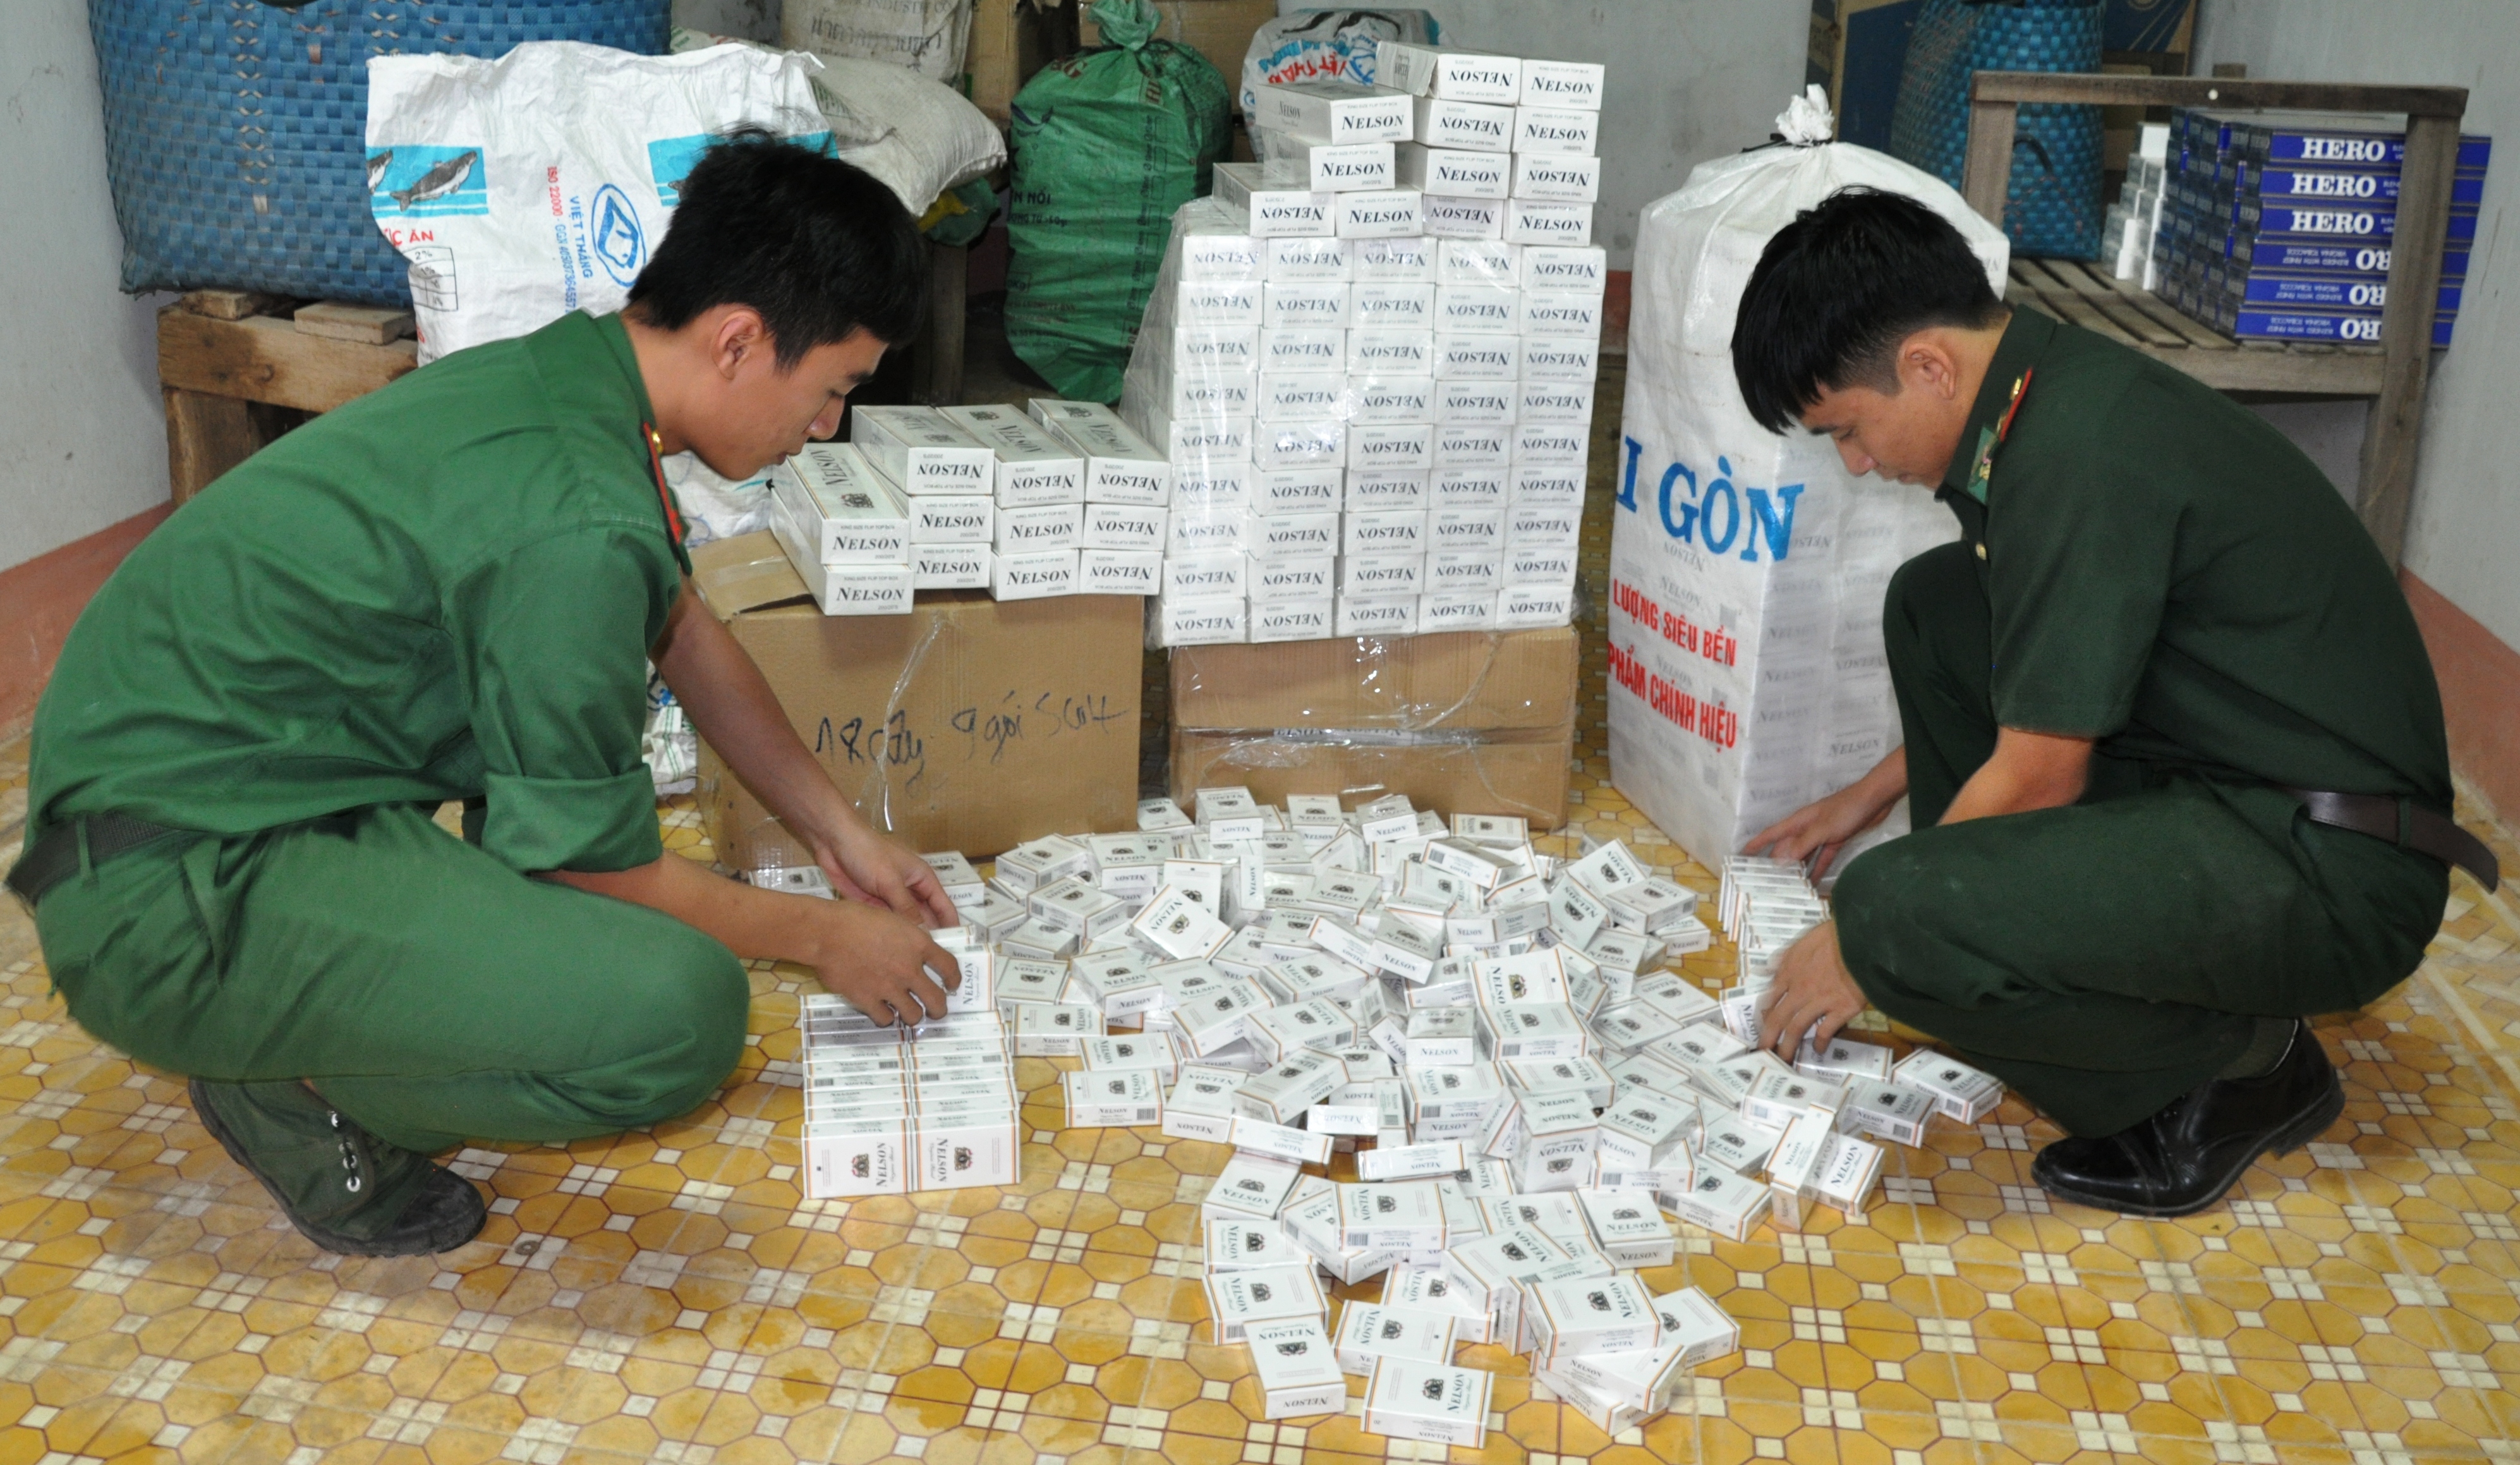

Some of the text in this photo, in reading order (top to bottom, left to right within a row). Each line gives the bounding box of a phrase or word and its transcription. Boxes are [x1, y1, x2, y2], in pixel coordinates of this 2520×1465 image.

[1450, 70, 1510, 87] NELSON
[1532, 76, 1594, 94] NELSON
[1342, 114, 1403, 130] NELSON
[1439, 116, 1505, 136] NELSON
[1525, 123, 1587, 141] NELSON
[2301, 137, 2385, 161] HERO
[548, 166, 558, 183] ISO
[1323, 162, 1385, 176] NELSON
[1436, 166, 1501, 183] NELSON
[1529, 169, 1590, 187] NELSON
[2291, 173, 2377, 198] HERO
[550, 186, 563, 216] 22000
[569, 196, 584, 229] VIỆT
[1261, 207, 1325, 221] NELSON
[1349, 209, 1414, 224] NELSON
[1430, 207, 1491, 224] NELSON
[1519, 215, 1582, 231] NELSON
[2291, 210, 2375, 234] HERO
[2355, 249, 2391, 271] RO
[1535, 264, 1596, 279] NELSON
[2348, 284, 2387, 306] RO
[1361, 300, 1425, 314] NELSON
[1528, 308, 1592, 324] NELSON
[2340, 319, 2382, 340] RO
[1360, 346, 1422, 360] NELSON
[1526, 352, 1590, 368] NELSON
[1364, 395, 1427, 410] NELSON
[1446, 396, 1509, 411] NELSON
[1362, 441, 1425, 455] NELSON
[917, 464, 984, 479] NELSON
[1010, 474, 1075, 490] NELSON
[1098, 473, 1162, 492] NELSON
[1439, 480, 1501, 494] NELSON
[1271, 484, 1334, 499] NELSON
[1659, 455, 1804, 562] GÒN
[919, 513, 985, 528] NELSON
[1094, 520, 1158, 536] NELSON
[1010, 523, 1072, 539] NELSON
[1357, 525, 1419, 540] NELSON
[832, 535, 901, 550] NELSON
[916, 559, 980, 574] NELSON
[1089, 566, 1153, 580] NELSON
[1357, 567, 1417, 581] NELSON
[1007, 569, 1070, 585] NELSON
[1175, 570, 1237, 585] NELSON
[836, 587, 905, 602] NELSON
[1350, 607, 1407, 621] NELSON
[1507, 601, 1565, 614] NELSON
[1613, 578, 1658, 631] LƯỢNG
[1663, 611, 1698, 653] SIÊU
[1174, 617, 1235, 631] NELSON
[1651, 674, 1695, 733] CHÍNH
[1699, 701, 1736, 753] HIỆU
[1376, 825, 1407, 836] NELSON
[1606, 850, 1635, 884] NELSON
[1319, 890, 1359, 902] NELSON
[1565, 886, 1597, 918] NELSON
[1151, 898, 1182, 931] NELSON
[1611, 906, 1636, 923] NELSON
[1671, 940, 1699, 948] NELSON
[1014, 966, 1057, 976] NELSON
[1384, 954, 1417, 972] NELSON
[963, 962, 973, 1005] NELSON
[1104, 975, 1147, 987] NELSON
[1119, 997, 1151, 1009] NELSON
[1308, 1002, 1336, 1026] NELSON
[1187, 1074, 1235, 1086] NELSON
[1539, 1098, 1575, 1107] NELSON
[1177, 1122, 1213, 1134] NELSON
[1611, 1114, 1657, 1134] NELSON
[1538, 1143, 1585, 1157] NELSON
[1601, 1138, 1636, 1157] NELSON
[876, 1141, 887, 1187] NELSON
[937, 1138, 948, 1182] NELSON
[1831, 1144, 1859, 1188] NELSON
[1223, 1188, 1271, 1204] NELSON
[1357, 1188, 1371, 1222] NELSON
[1606, 1222, 1658, 1231] NELSON
[1228, 1225, 1239, 1259] NELSON
[1515, 1231, 1551, 1263] NELSON
[1620, 1251, 1659, 1260] NELSON
[1229, 1277, 1249, 1312] NELSON
[1609, 1282, 1634, 1318] NELSON
[1259, 1328, 1316, 1340] NELSON
[1360, 1308, 1381, 1346] NELSON
[1571, 1359, 1603, 1377] NELSON
[1446, 1373, 1465, 1413] NELSON
[1283, 1396, 1329, 1407] NELSON
[1419, 1430, 1453, 1441] NELSON
